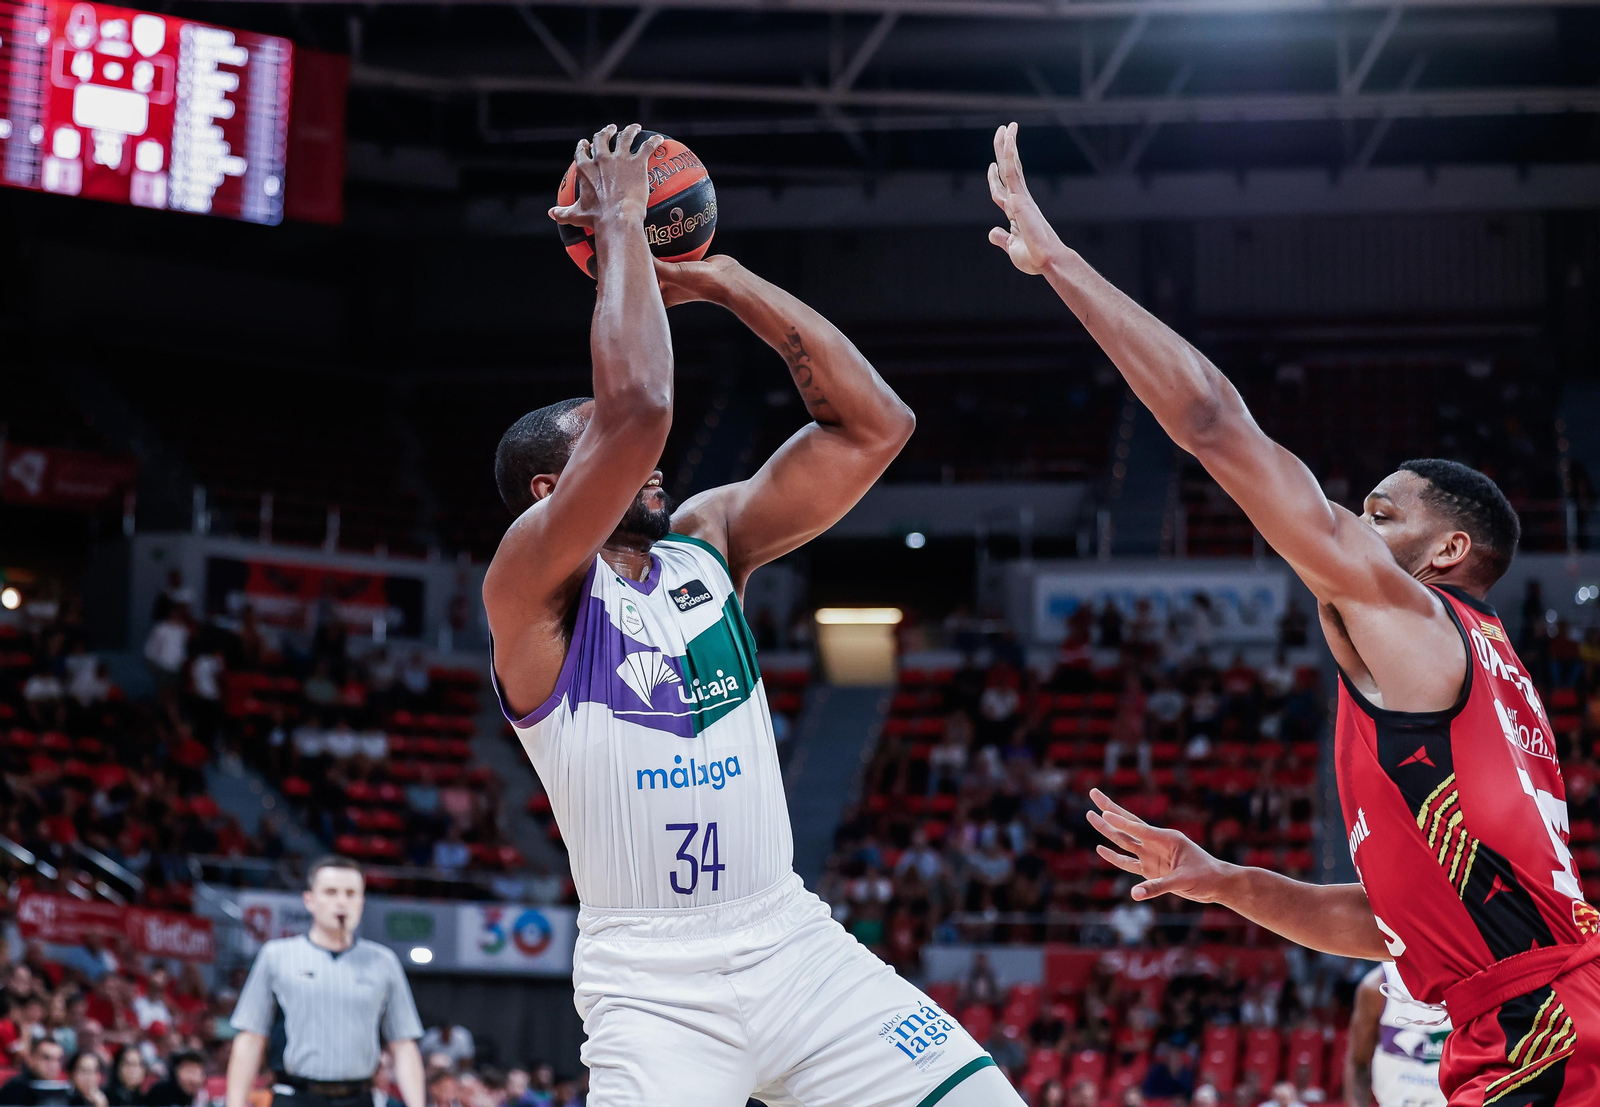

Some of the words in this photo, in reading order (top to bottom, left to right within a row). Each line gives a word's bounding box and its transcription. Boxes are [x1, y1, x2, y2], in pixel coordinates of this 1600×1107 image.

[647, 150, 704, 194] PALDIN
[645, 222, 684, 246] liga
[684, 201, 717, 233] ende
[673, 592, 690, 604] liga
[679, 592, 711, 610] endesa
[636, 754, 742, 791] málaga
[665, 822, 726, 895] 34
[878, 1013, 902, 1038] sabor
[885, 1035, 896, 1044] a
[894, 1000, 941, 1041] má
[895, 1018, 955, 1061] laga
